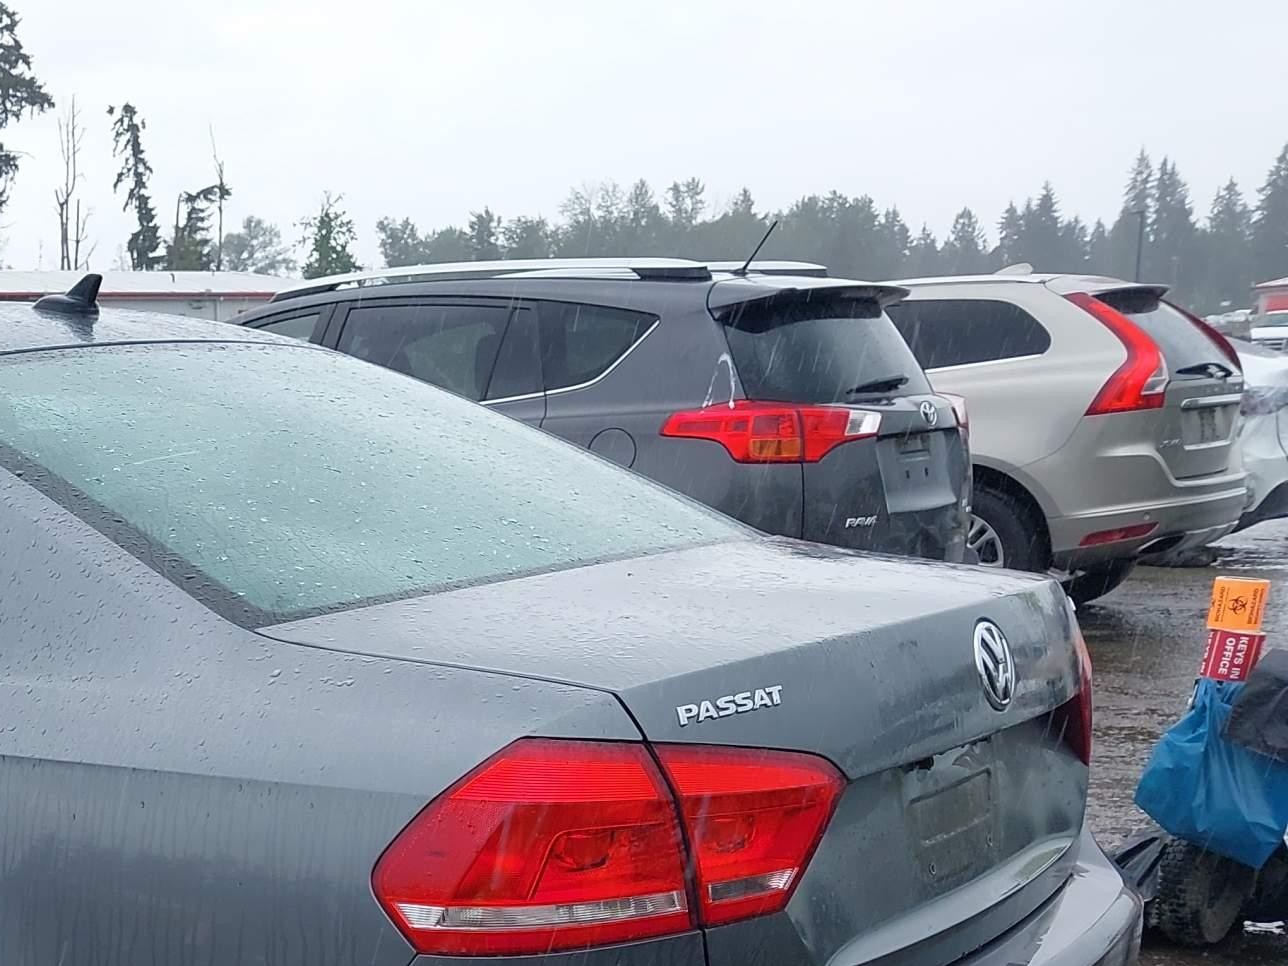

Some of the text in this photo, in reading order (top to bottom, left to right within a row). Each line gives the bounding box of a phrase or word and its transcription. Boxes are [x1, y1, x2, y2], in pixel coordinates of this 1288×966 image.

[1217, 637, 1236, 676] OFFICE
[1229, 636, 1250, 680] KEYS IN
[676, 685, 783, 726] PASSAT
